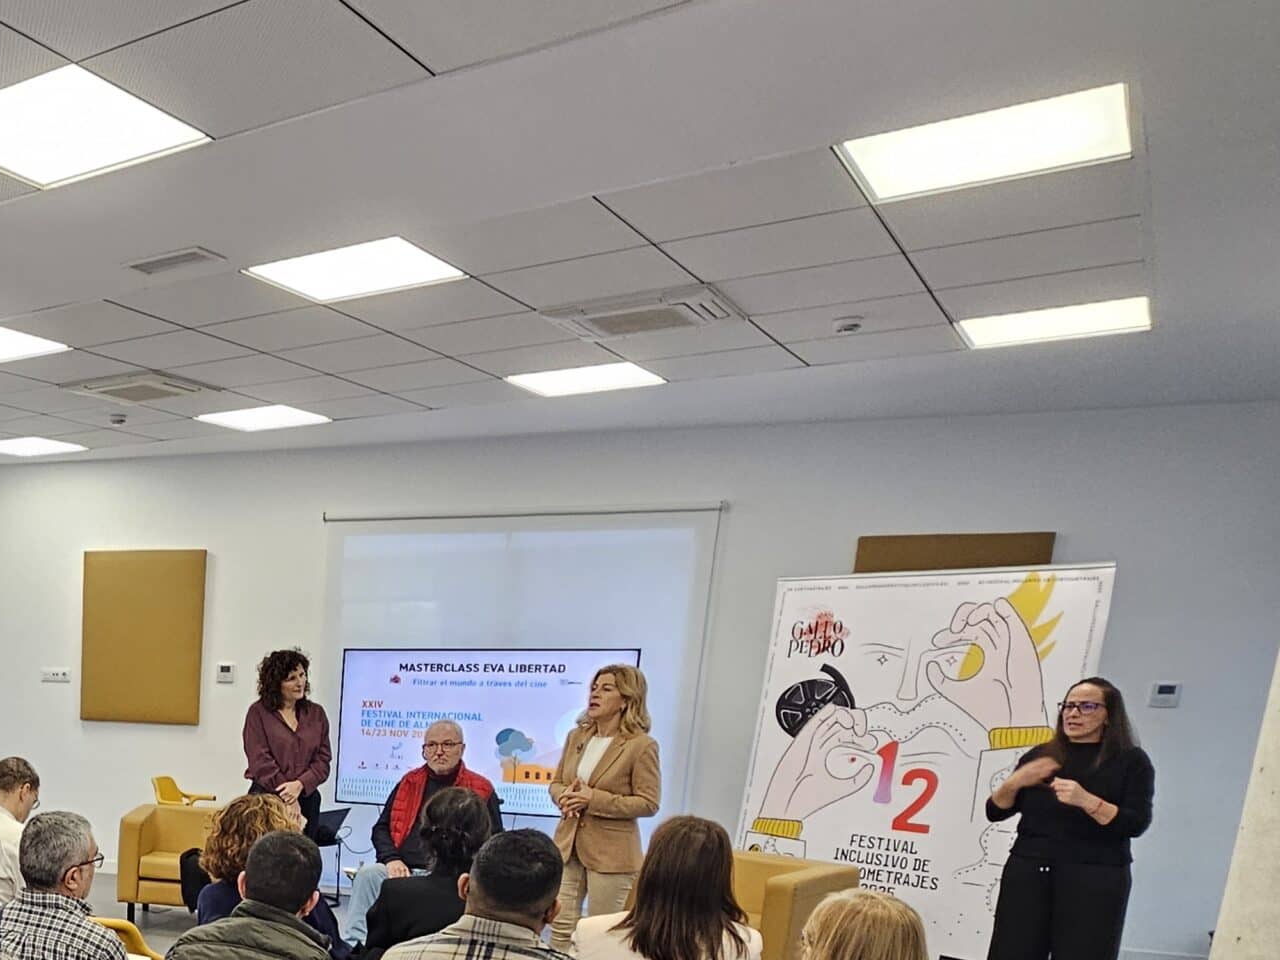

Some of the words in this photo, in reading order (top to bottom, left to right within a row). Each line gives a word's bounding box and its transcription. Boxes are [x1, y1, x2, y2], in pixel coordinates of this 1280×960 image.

[791, 620, 843, 640] GALLO
[787, 639, 845, 658] PEDRO
[399, 663, 480, 673] MASTERCLASS
[483, 663, 505, 673] EVA
[508, 663, 566, 673] LIBERTAD
[361, 700, 384, 708] XXIV
[361, 710, 403, 719] FESTIVAL
[406, 711, 483, 721] INTERNACIONAL
[361, 719, 371, 727] DE
[375, 720, 394, 728] CINE
[399, 720, 410, 728] DE
[389, 729, 409, 737] NOV
[849, 834, 918, 854] FESTIVAL
[833, 847, 908, 870] INCLUSIVO
[912, 858, 931, 872] DE
[858, 867, 939, 890] OMETRAJES
